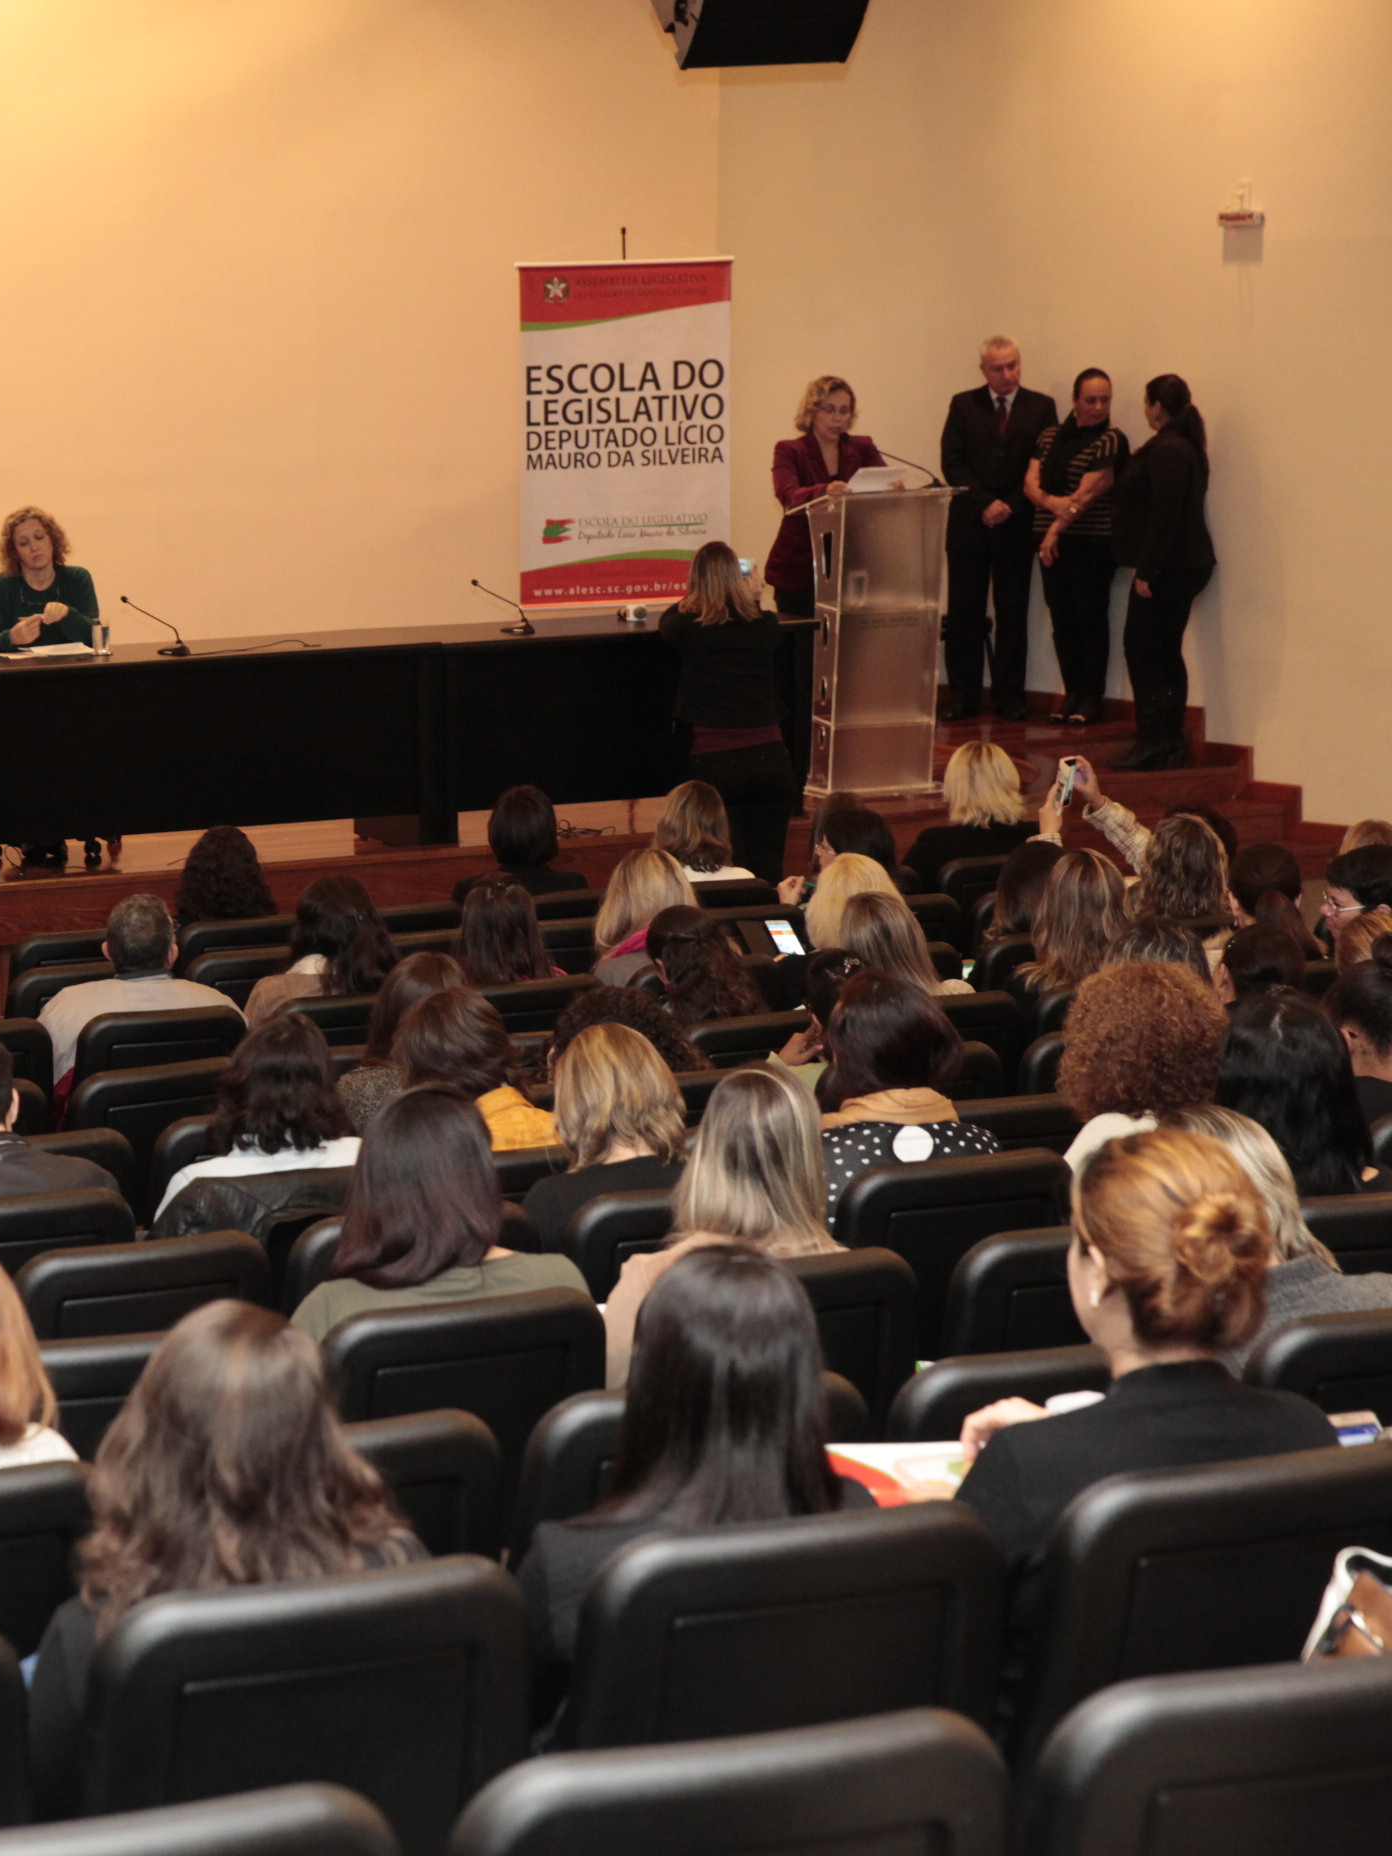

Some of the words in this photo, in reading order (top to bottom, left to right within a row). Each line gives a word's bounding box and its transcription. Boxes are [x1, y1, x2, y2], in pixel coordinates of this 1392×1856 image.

[526, 362, 661, 395] ESCOLA
[673, 359, 724, 390] DO
[526, 393, 724, 426] LEGISLATIVO
[526, 427, 657, 451] DEPUTADO
[665, 421, 724, 446] LÍCIO
[526, 452, 601, 470] MAURO
[608, 450, 635, 468] DA
[641, 447, 724, 466] SILVEIRA
[578, 517, 618, 528] ESCOLA
[622, 516, 639, 526] DO
[642, 512, 708, 525] LEGISLATIVO
[533, 582, 687, 597] www.alesc.sc.gov.br/es
